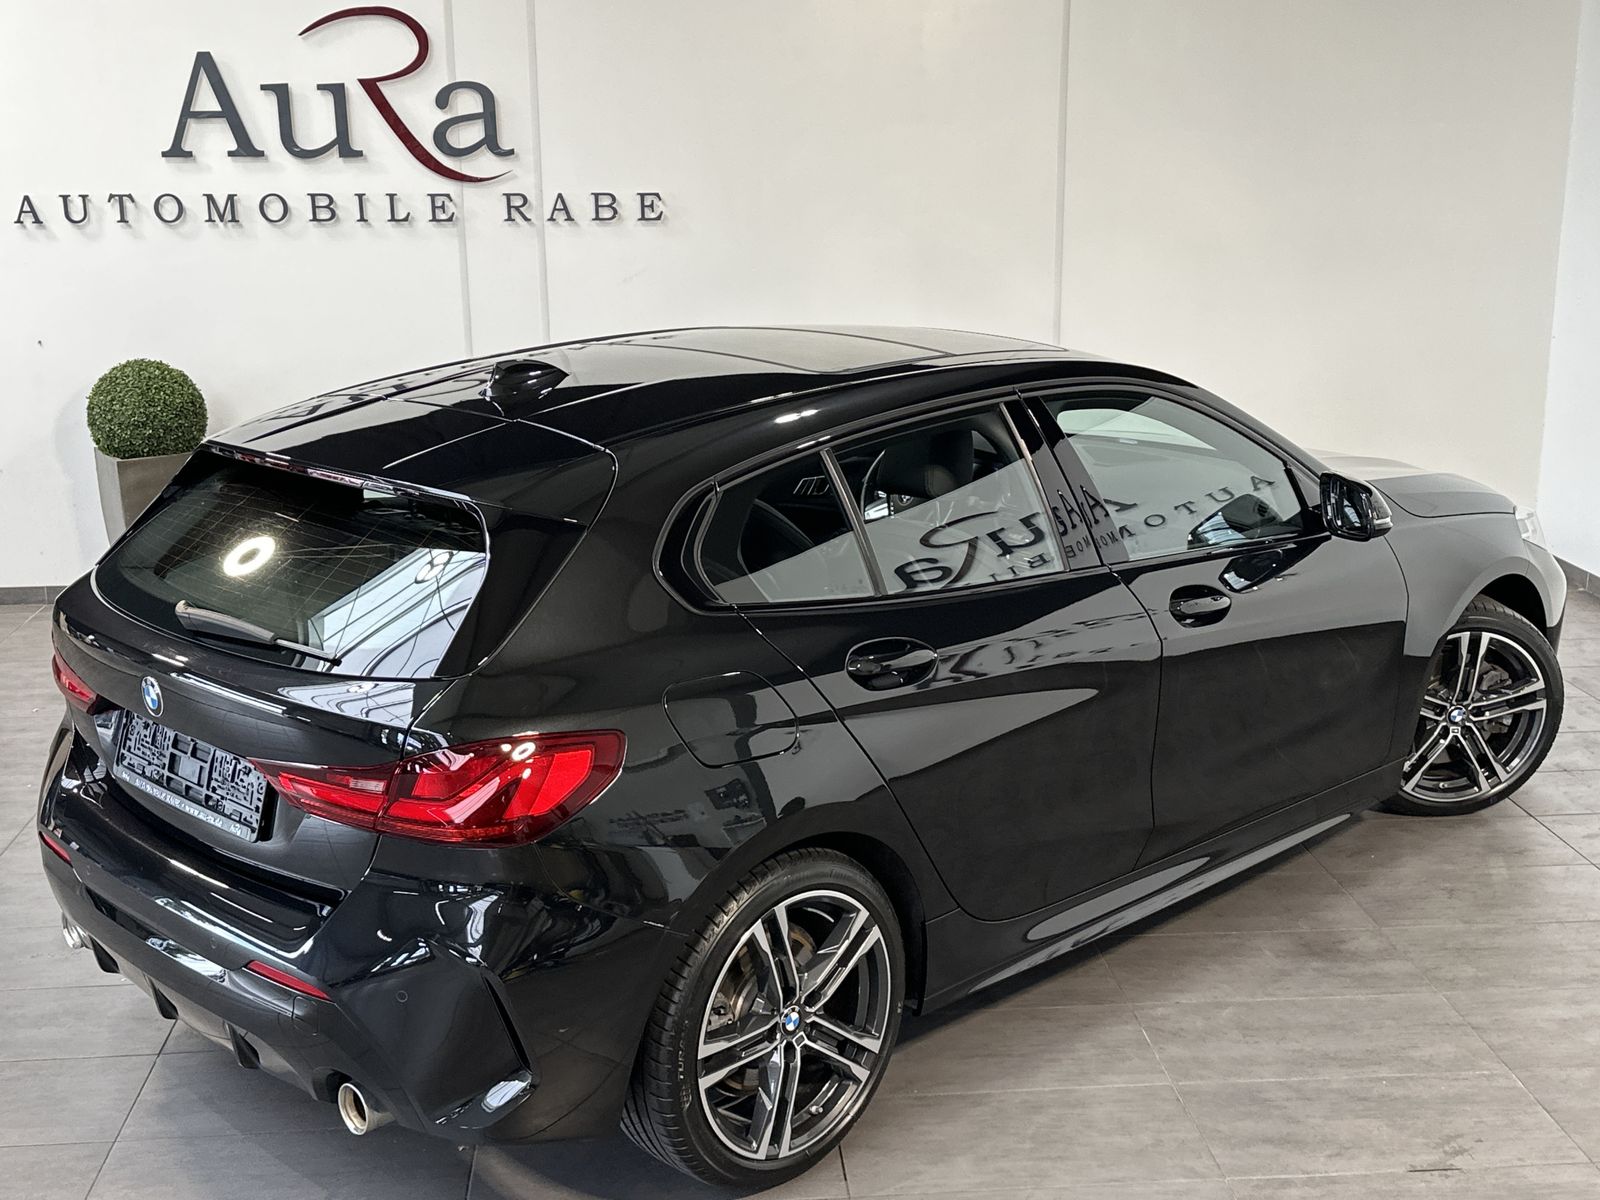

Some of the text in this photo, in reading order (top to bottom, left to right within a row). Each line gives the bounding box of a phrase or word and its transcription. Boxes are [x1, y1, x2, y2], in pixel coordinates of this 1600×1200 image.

[161, 6, 515, 183] AuRa
[14, 191, 665, 225] AUTOMOBILE RABE
